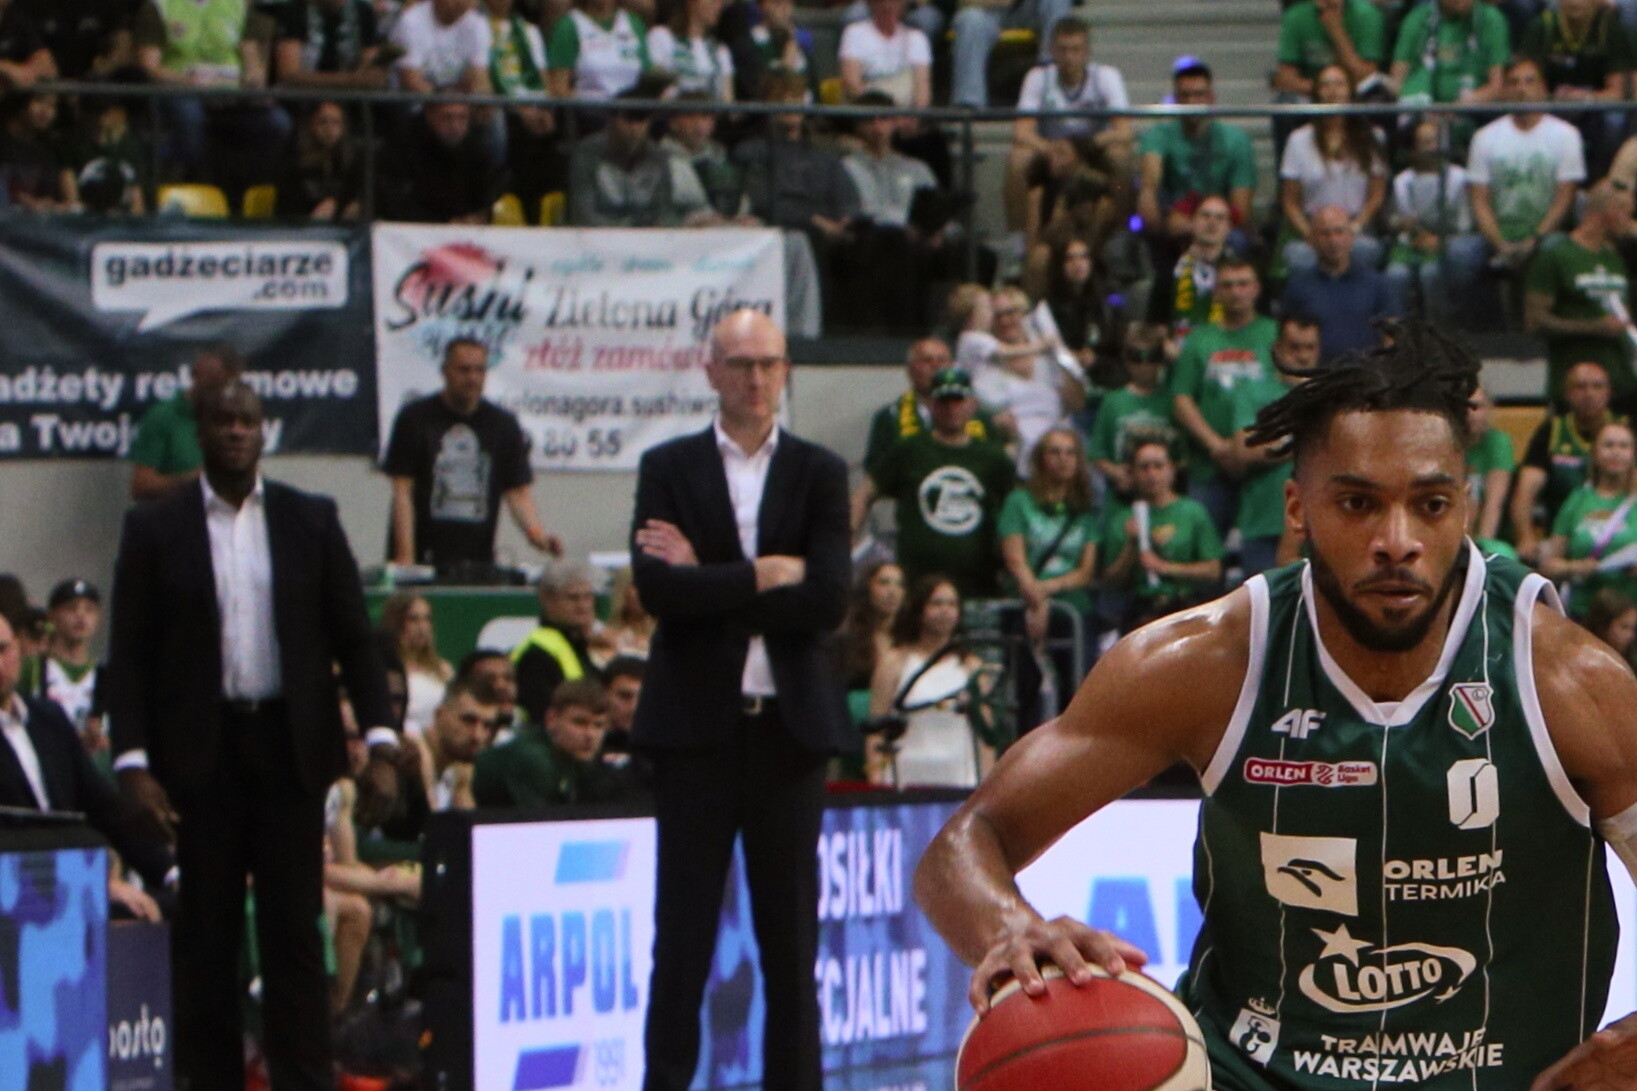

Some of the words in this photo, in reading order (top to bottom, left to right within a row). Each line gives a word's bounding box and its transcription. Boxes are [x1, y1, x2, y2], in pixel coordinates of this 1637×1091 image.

[1271, 708, 1326, 740] 4F
[1251, 763, 1307, 780] ORLEN
[1447, 757, 1500, 830] 0
[1384, 850, 1503, 880] ORLEN
[1384, 870, 1506, 900] TERMIKA
[500, 908, 637, 1023] ARPOL
[1334, 957, 1443, 1000] LOTTO
[1321, 1028, 1487, 1057] TRAMWAJE
[1293, 1043, 1504, 1083] WARSZAWSKIE
